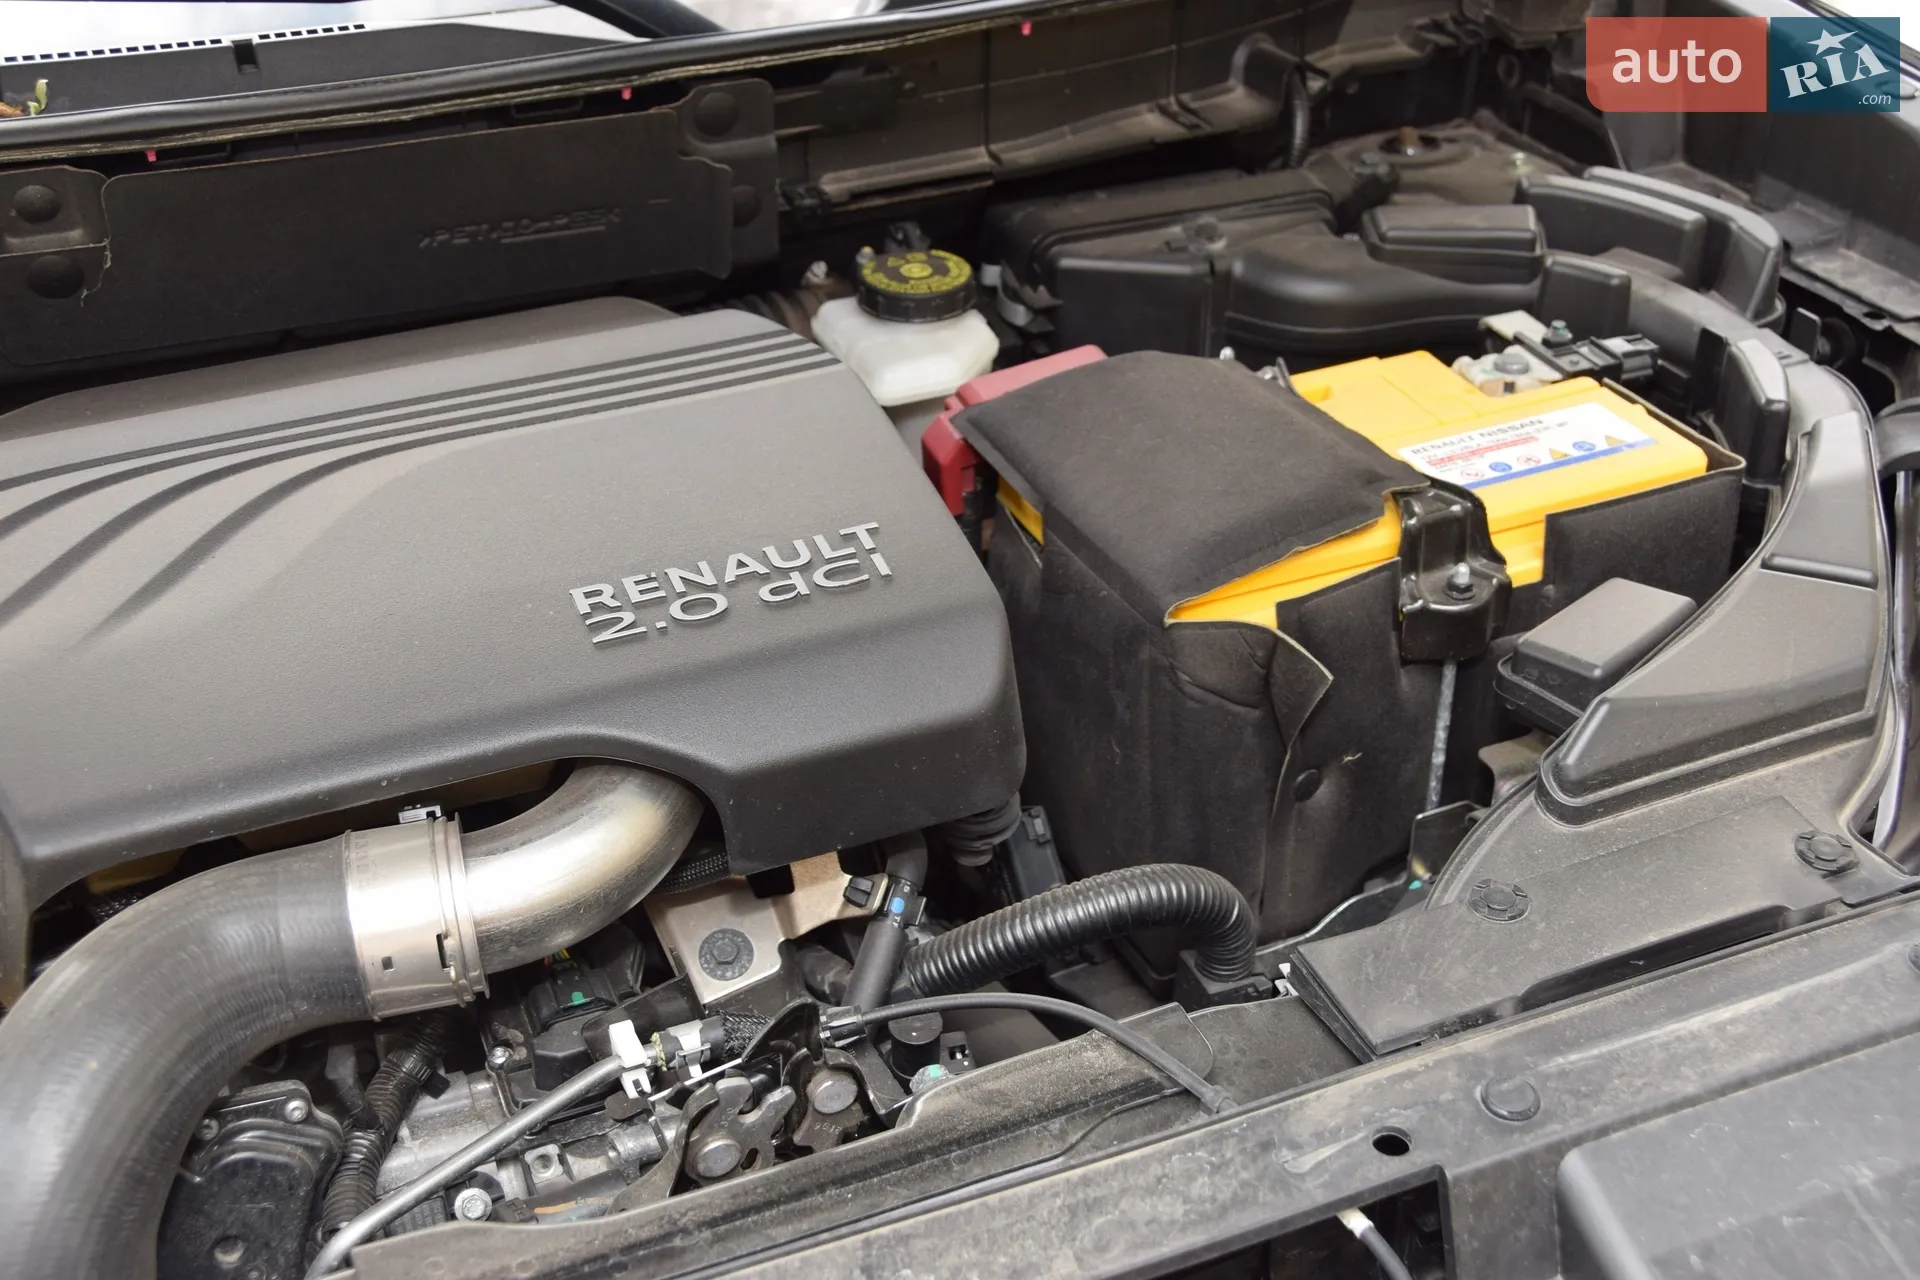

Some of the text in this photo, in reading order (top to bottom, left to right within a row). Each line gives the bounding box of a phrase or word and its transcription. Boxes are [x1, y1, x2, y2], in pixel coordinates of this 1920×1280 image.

[1411, 434, 1477, 455] RENAULT
[1480, 419, 1544, 439] NISSAN
[568, 521, 880, 616] RENAULT
[585, 592, 729, 644] 2.0
